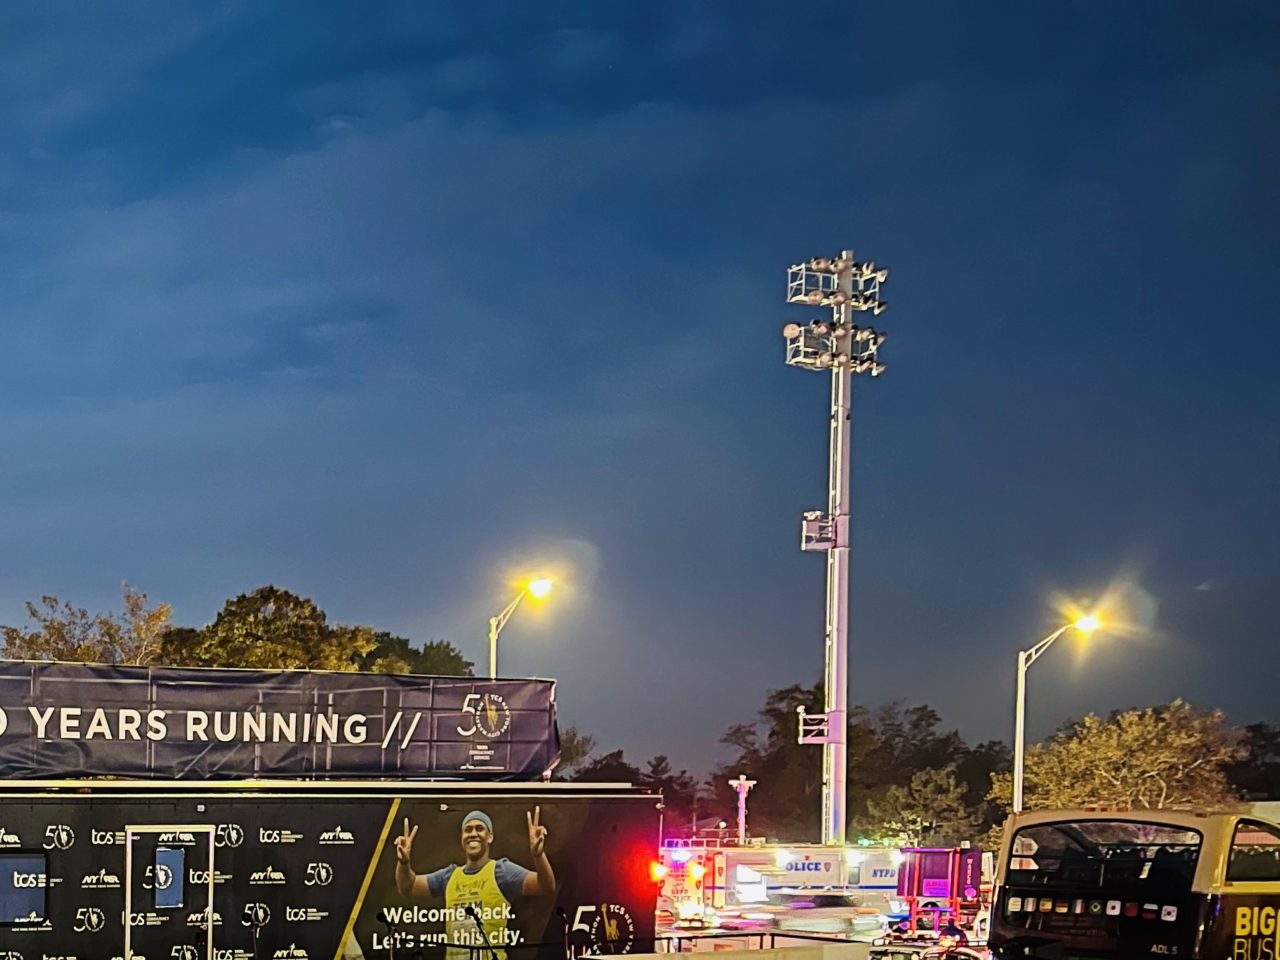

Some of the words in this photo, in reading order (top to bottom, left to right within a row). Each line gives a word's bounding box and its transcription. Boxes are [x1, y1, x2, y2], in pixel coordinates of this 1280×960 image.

[27, 706, 167, 741] YEARS
[185, 710, 368, 744] RUNNING
[92, 829, 114, 845] tcs
[259, 827, 280, 843] tcs
[13, 871, 37, 888] tcs
[871, 868, 896, 878] NYPD
[286, 906, 306, 921] tcs
[383, 905, 466, 925] Welcome
[609, 904, 626, 915] TCS
[1235, 906, 1275, 937] BIG
[372, 931, 415, 951] Let's
[453, 927, 484, 946] this
[489, 926, 525, 947] city.
[1150, 944, 1170, 955] ADL
